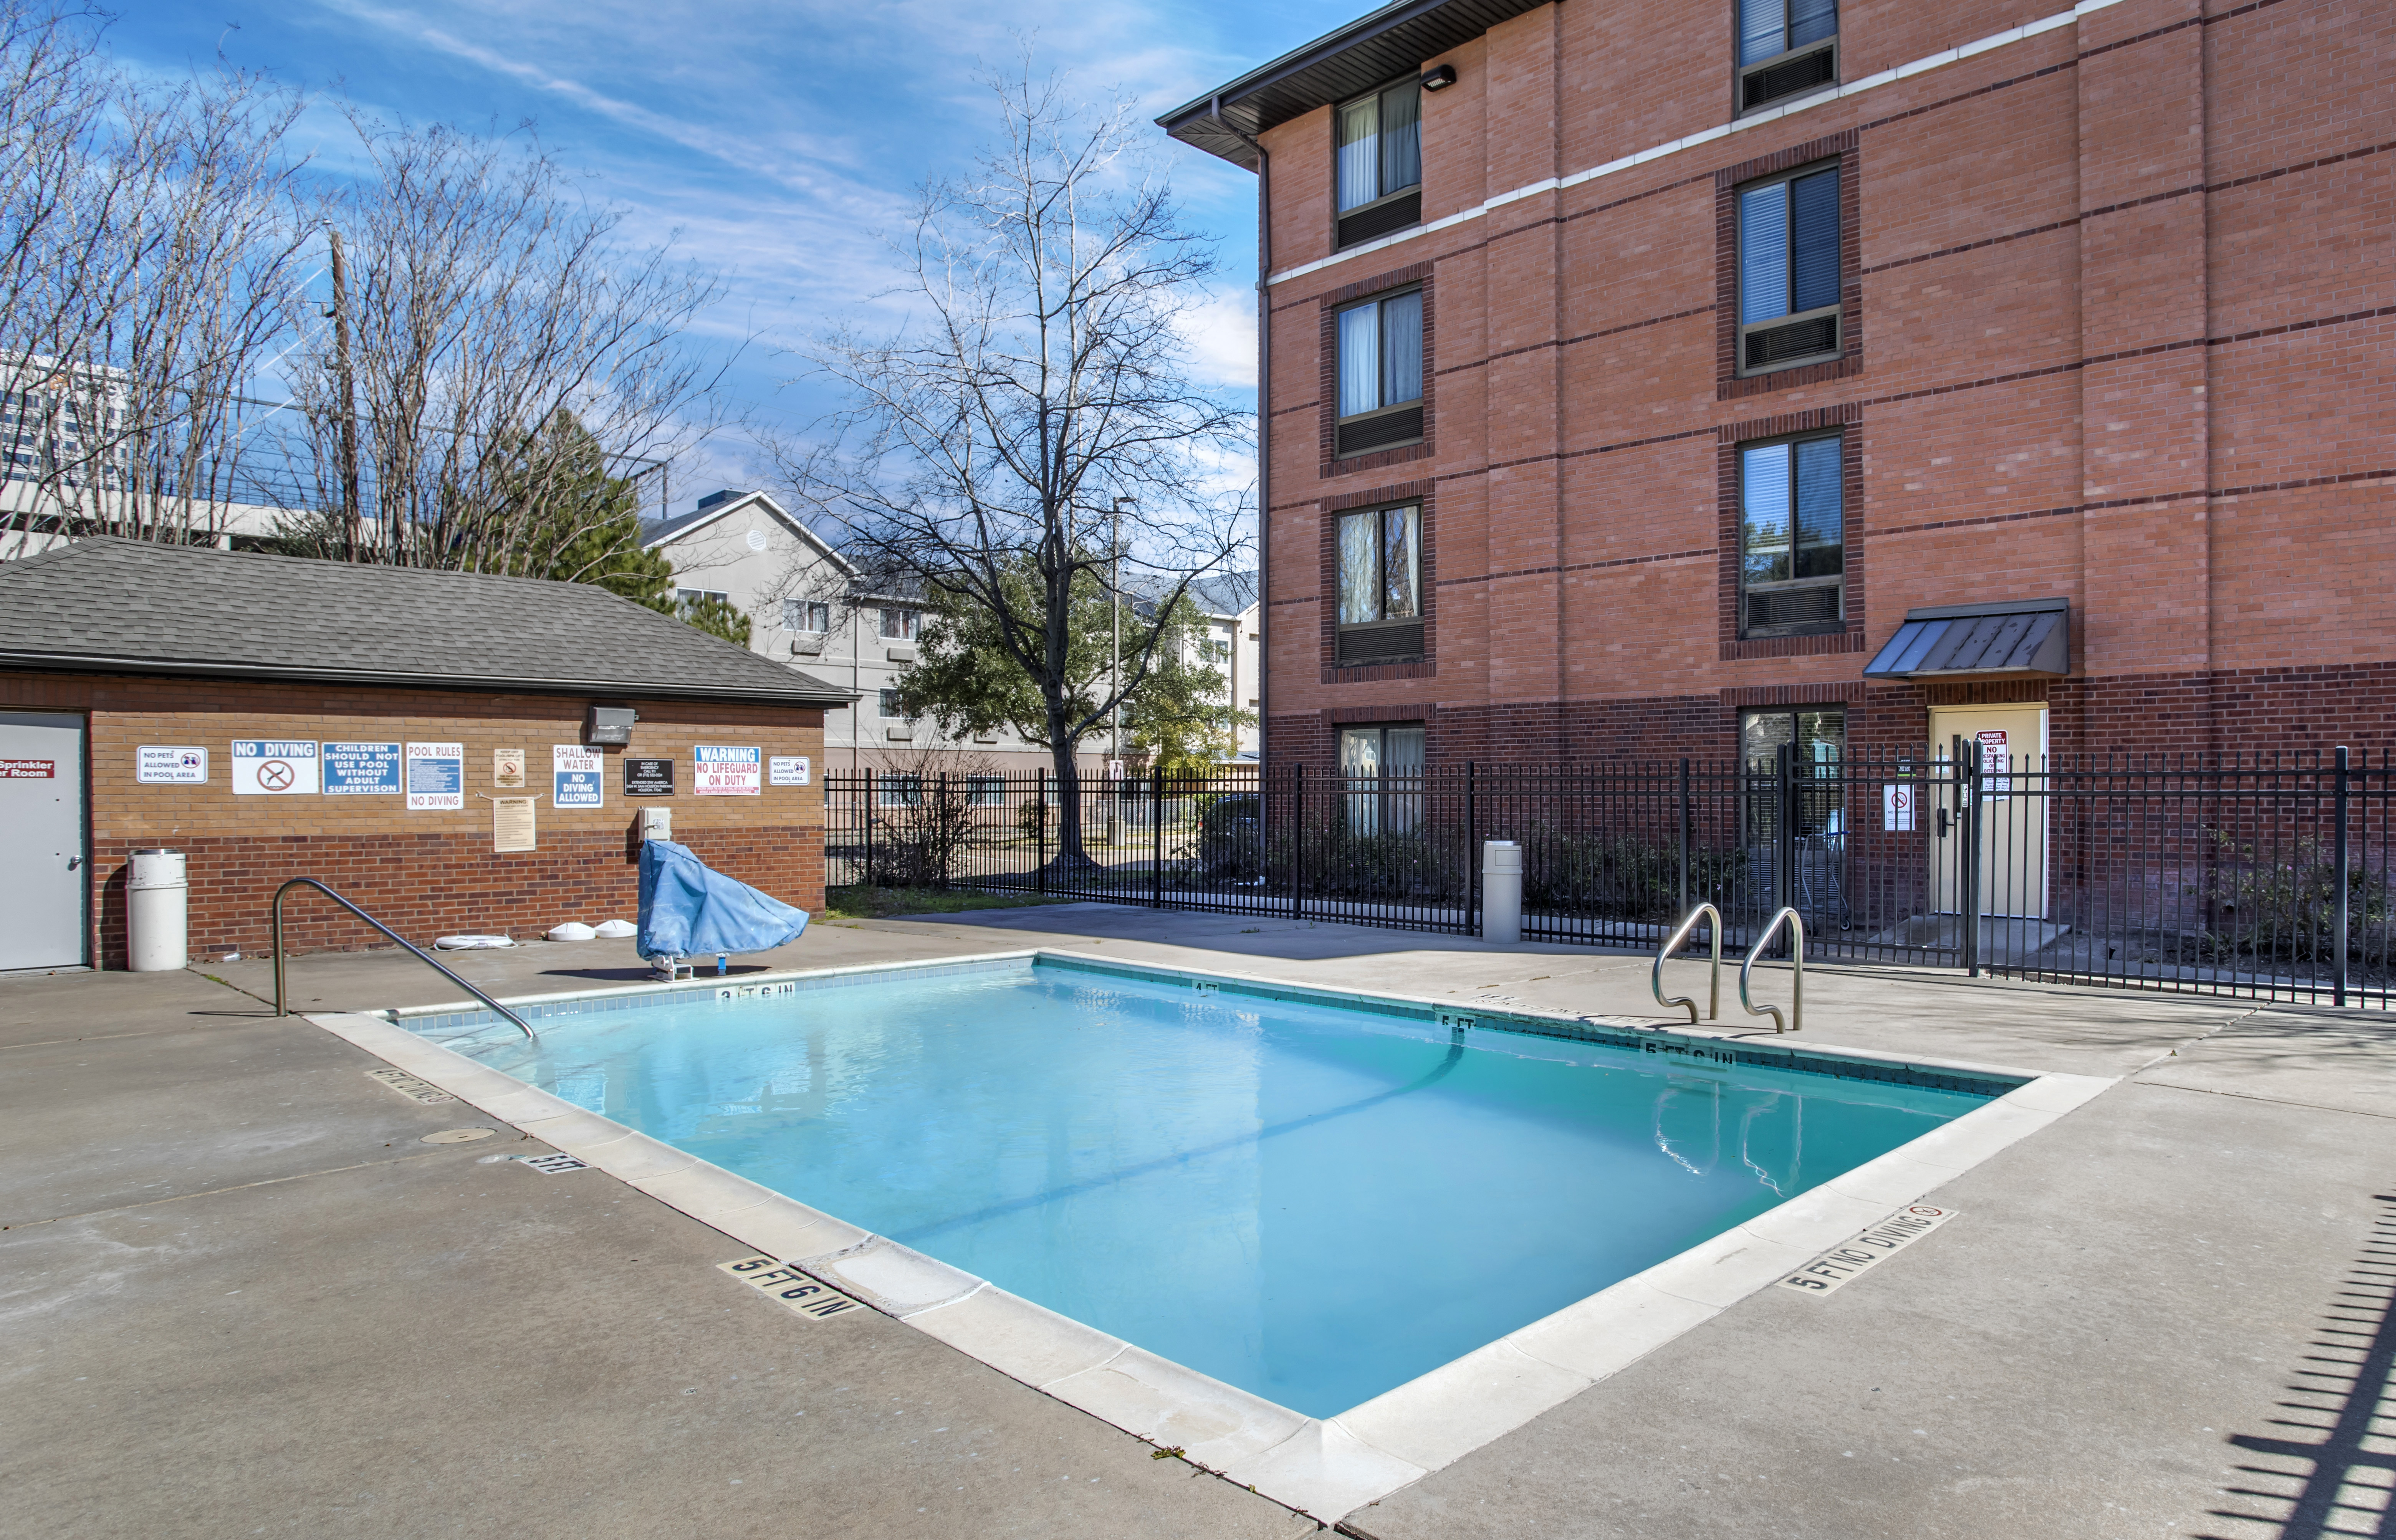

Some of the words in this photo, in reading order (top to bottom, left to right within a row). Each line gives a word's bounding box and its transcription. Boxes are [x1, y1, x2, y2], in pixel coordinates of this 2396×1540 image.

[236, 743, 256, 756] NO
[265, 743, 313, 756] DIVING
[409, 747, 432, 756] POOL
[436, 747, 460, 756] RULES
[556, 748, 601, 758] SHALLOW
[700, 748, 755, 762] WARNING
[0, 761, 53, 770] Sprinkler
[563, 760, 594, 769] WATER
[697, 763, 708, 773] NO
[712, 763, 758, 773] LIFEGUARD
[709, 775, 721, 785] ON
[725, 775, 746, 785] DUTY
[412, 796, 424, 806] NO
[429, 796, 458, 805] DIVING
[779, 984, 793, 993] IN
[1458, 1017, 1474, 1029] FT
[1646, 1042, 1656, 1053] 5
[1715, 1052, 1732, 1064] IN
[397, 1083, 443, 1098] DIVING
[538, 1160, 587, 1171] FT
[1859, 1216, 1933, 1249] DIVING
[1828, 1249, 1876, 1266] NO
[732, 1259, 774, 1271] 5
[1804, 1261, 1854, 1279] FT
[748, 1269, 804, 1287] FT
[1786, 1277, 1828, 1290] 5
[781, 1285, 821, 1299] 6
[801, 1296, 856, 1317] IN
